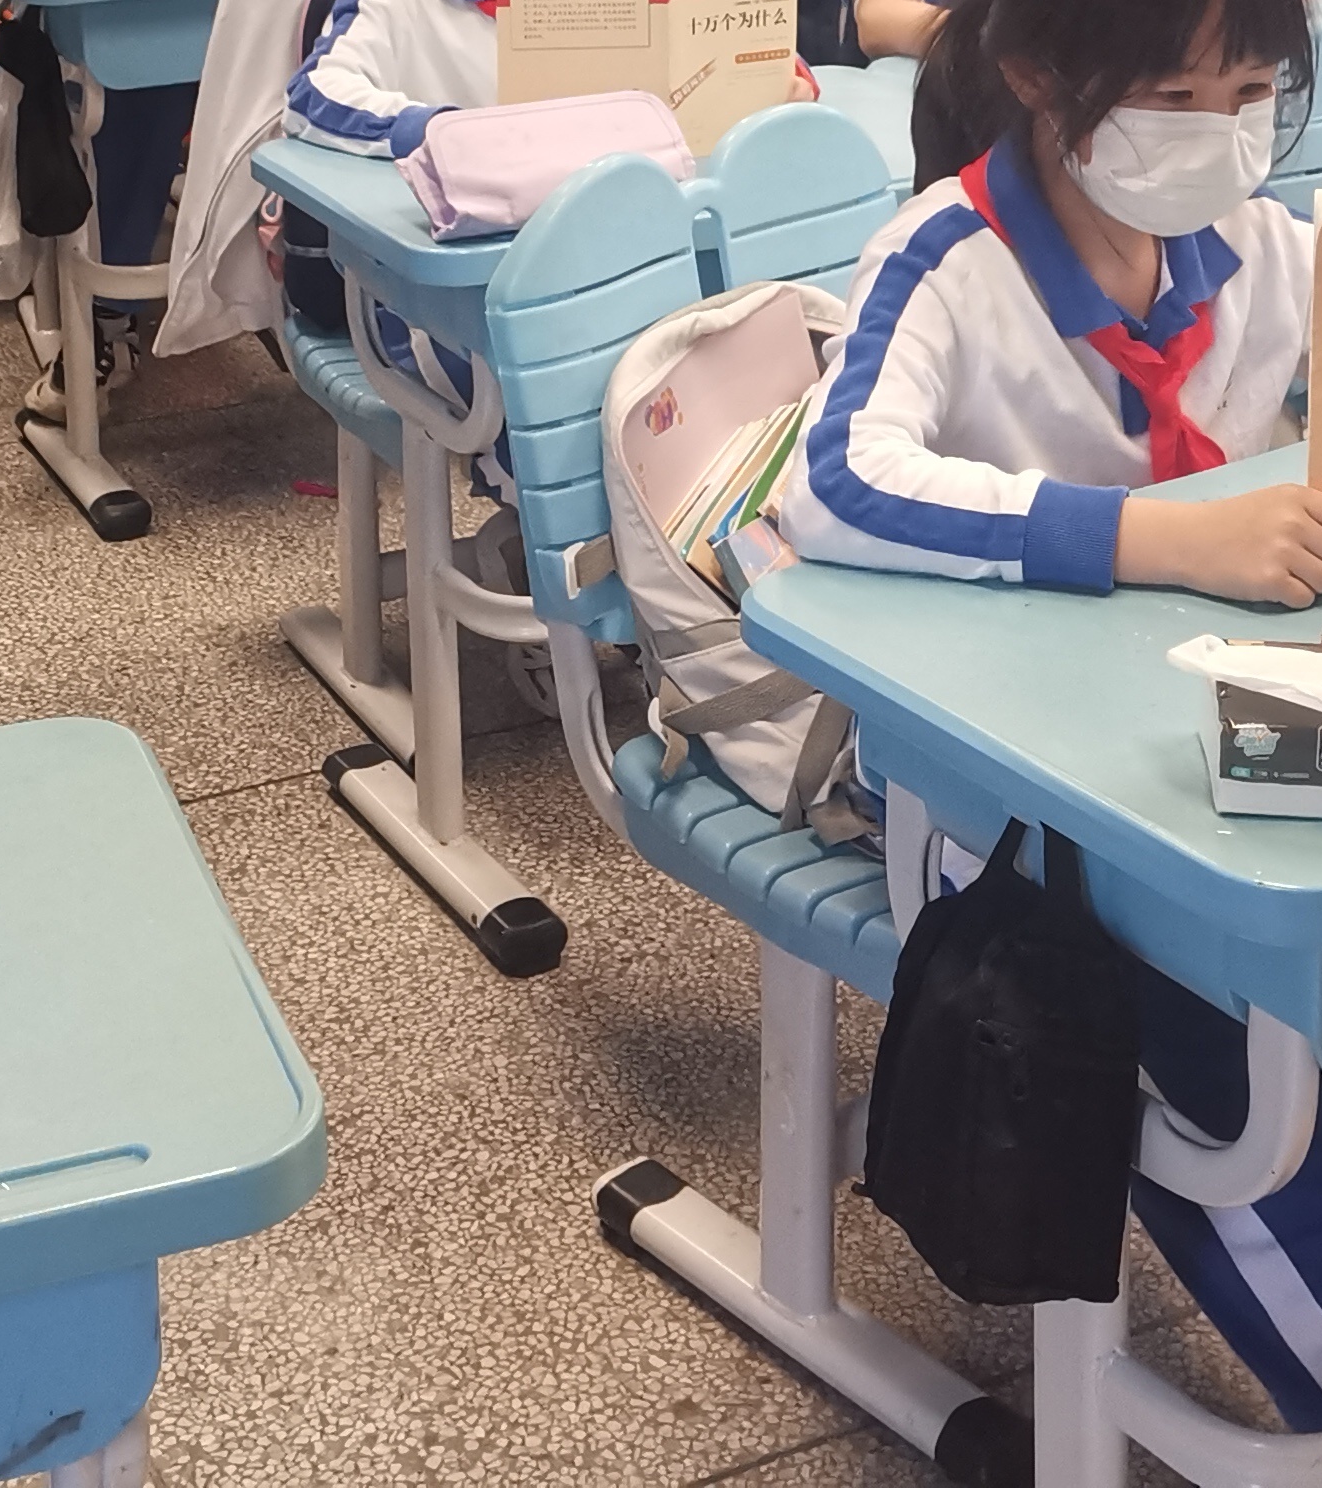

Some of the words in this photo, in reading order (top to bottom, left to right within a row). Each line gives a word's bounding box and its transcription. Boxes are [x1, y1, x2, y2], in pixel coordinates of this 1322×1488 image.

[690, 7, 788, 35] 十万个为什么
